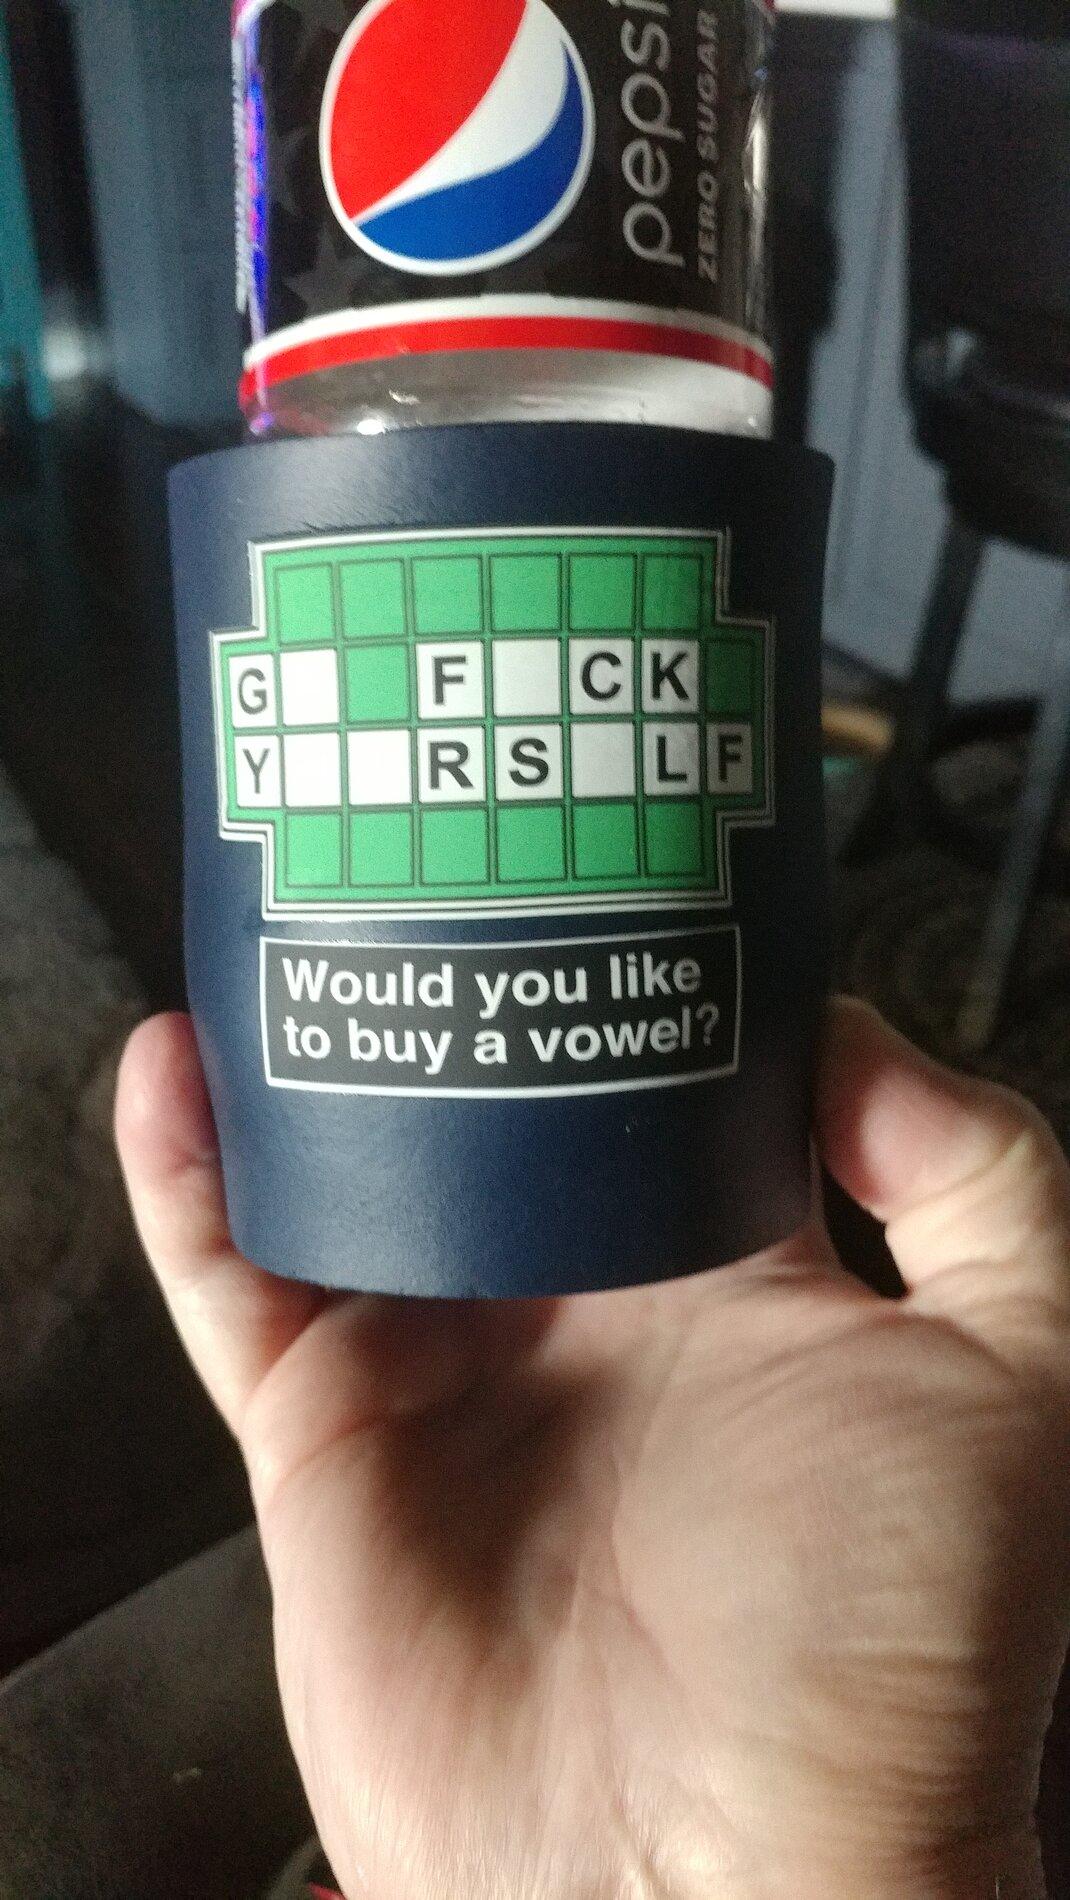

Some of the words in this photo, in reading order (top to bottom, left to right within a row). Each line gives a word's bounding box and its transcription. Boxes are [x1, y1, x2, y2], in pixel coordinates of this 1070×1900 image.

[607, 0, 685, 267] pepsi
[697, 10, 719, 162] SUGAR
[697, 171, 719, 283] ZERO
[281, 956, 456, 1008] Would
[474, 968, 588, 1019] you
[608, 952, 702, 1001] like
[282, 1014, 332, 1061] to
[347, 1018, 453, 1075] buy
[472, 1030, 508, 1066] a
[527, 1001, 721, 1064] vowel?
